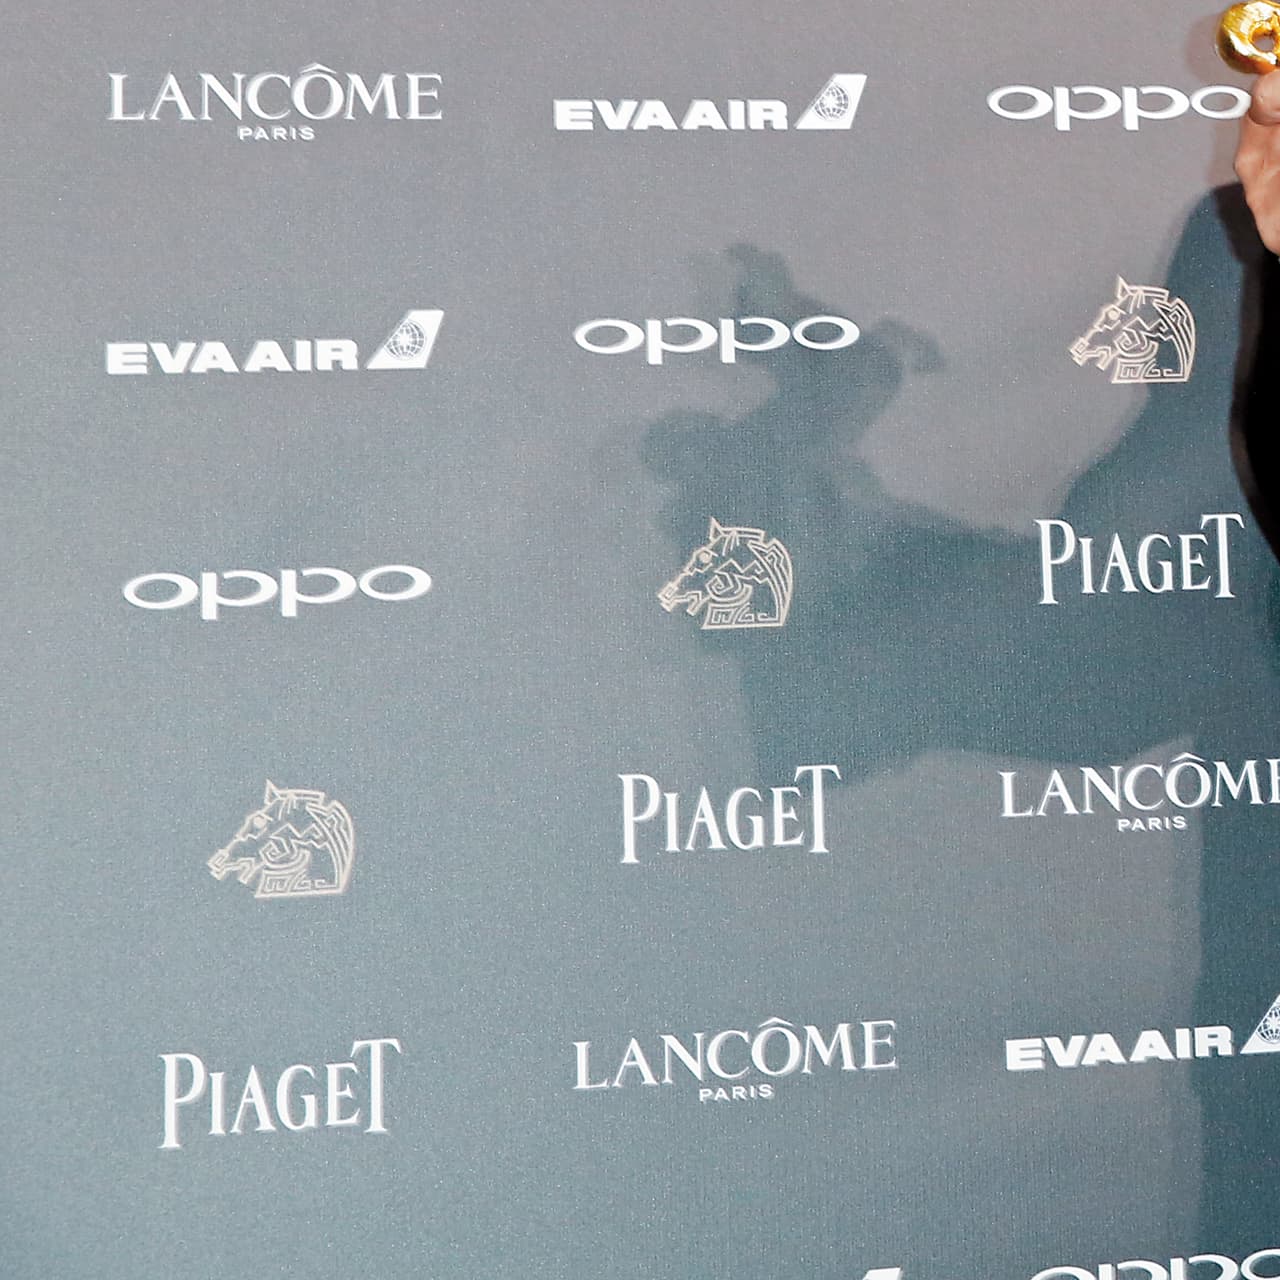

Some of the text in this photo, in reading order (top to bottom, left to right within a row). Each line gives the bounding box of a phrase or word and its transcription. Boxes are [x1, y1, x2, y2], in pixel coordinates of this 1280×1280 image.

[108, 63, 442, 120] LANCÔME
[988, 86, 1249, 130] oppo
[238, 126, 314, 140] PARIS
[574, 316, 859, 364] oppo
[1034, 514, 1244, 604] PIAGET
[124, 565, 431, 620] oppo
[618, 765, 840, 863] PIAGET
[1117, 816, 1187, 832] PARIS
[573, 1017, 897, 1089] LANCÔME
[160, 1039, 401, 1148] PIAGET
[700, 1084, 773, 1101] PARIS
